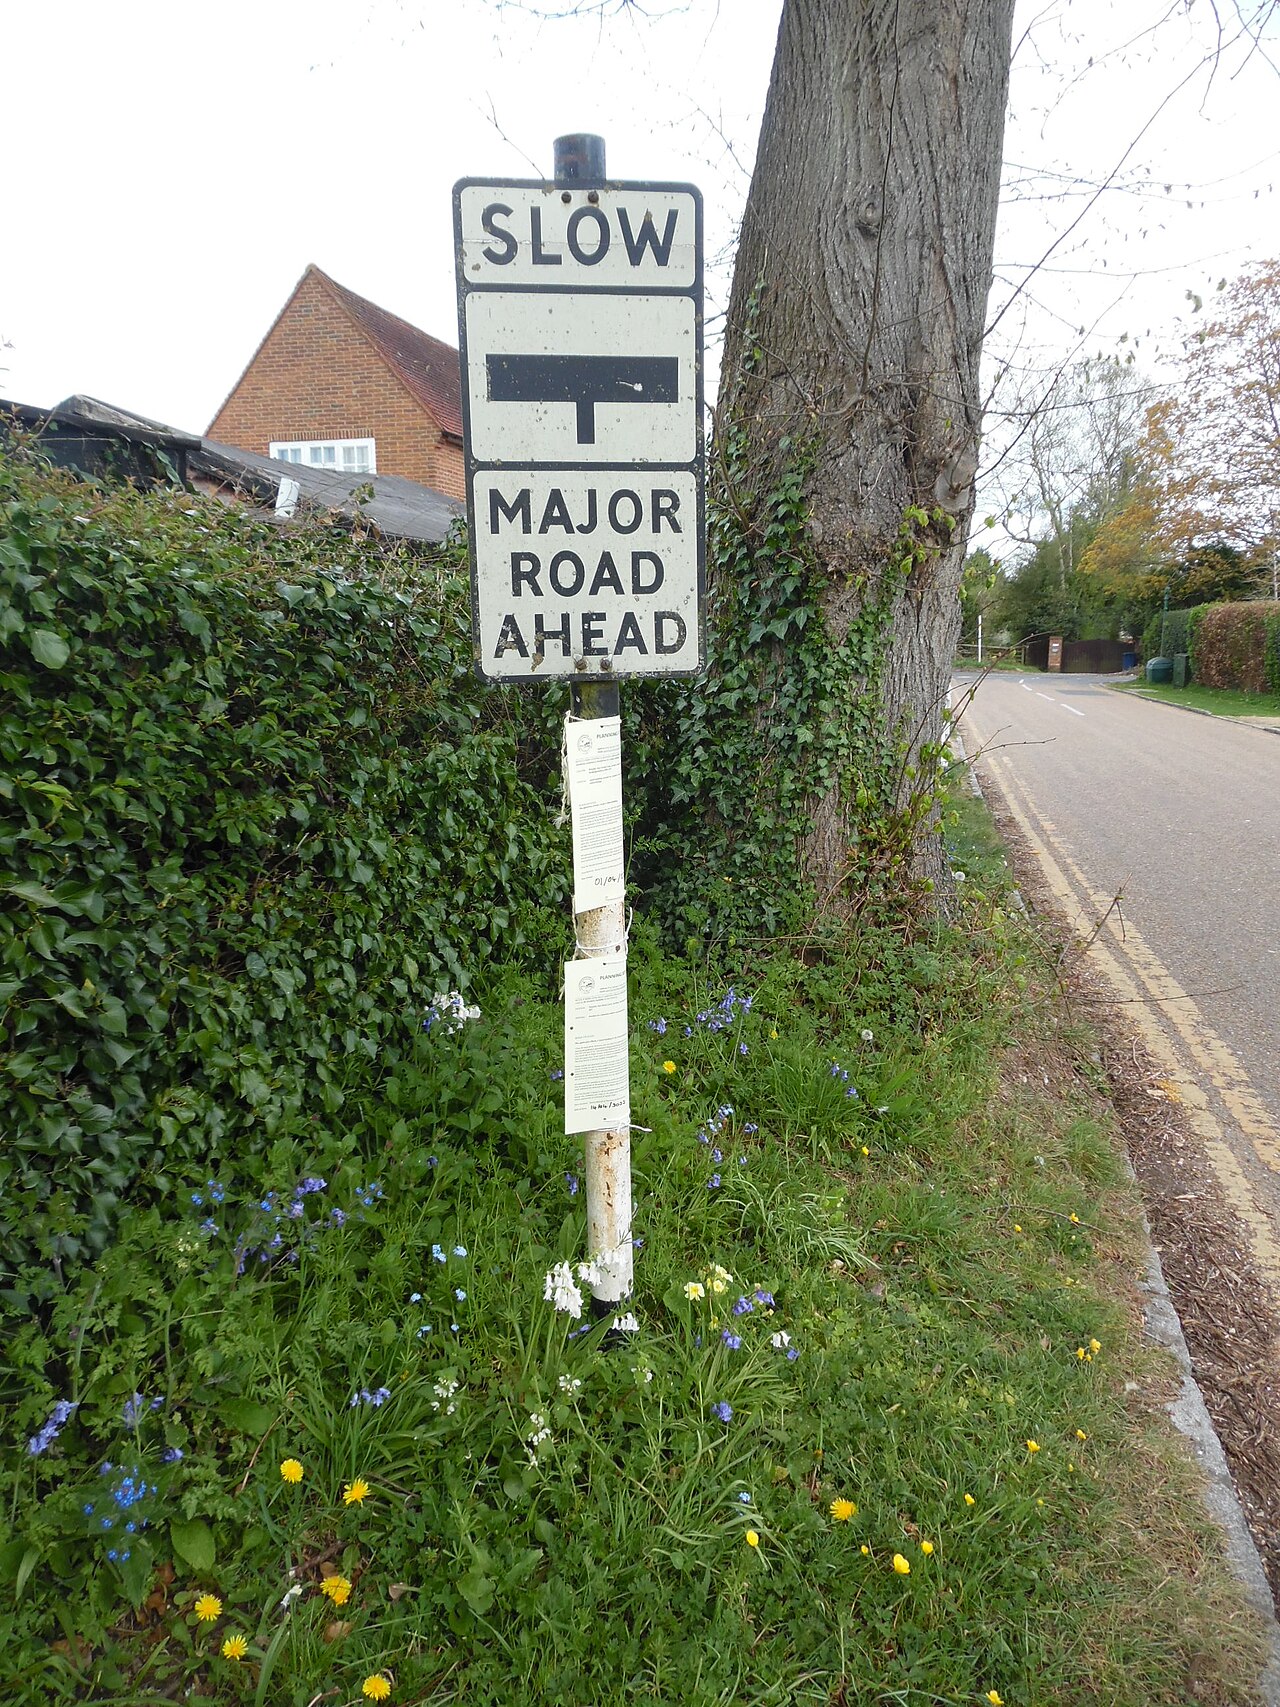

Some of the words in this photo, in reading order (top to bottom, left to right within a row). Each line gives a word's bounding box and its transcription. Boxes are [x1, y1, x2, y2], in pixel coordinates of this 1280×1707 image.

[481, 203, 679, 267] SLOW
[489, 488, 683, 535] MAJOR
[510, 550, 665, 597] ROAD
[493, 611, 687, 659] AHEAD
